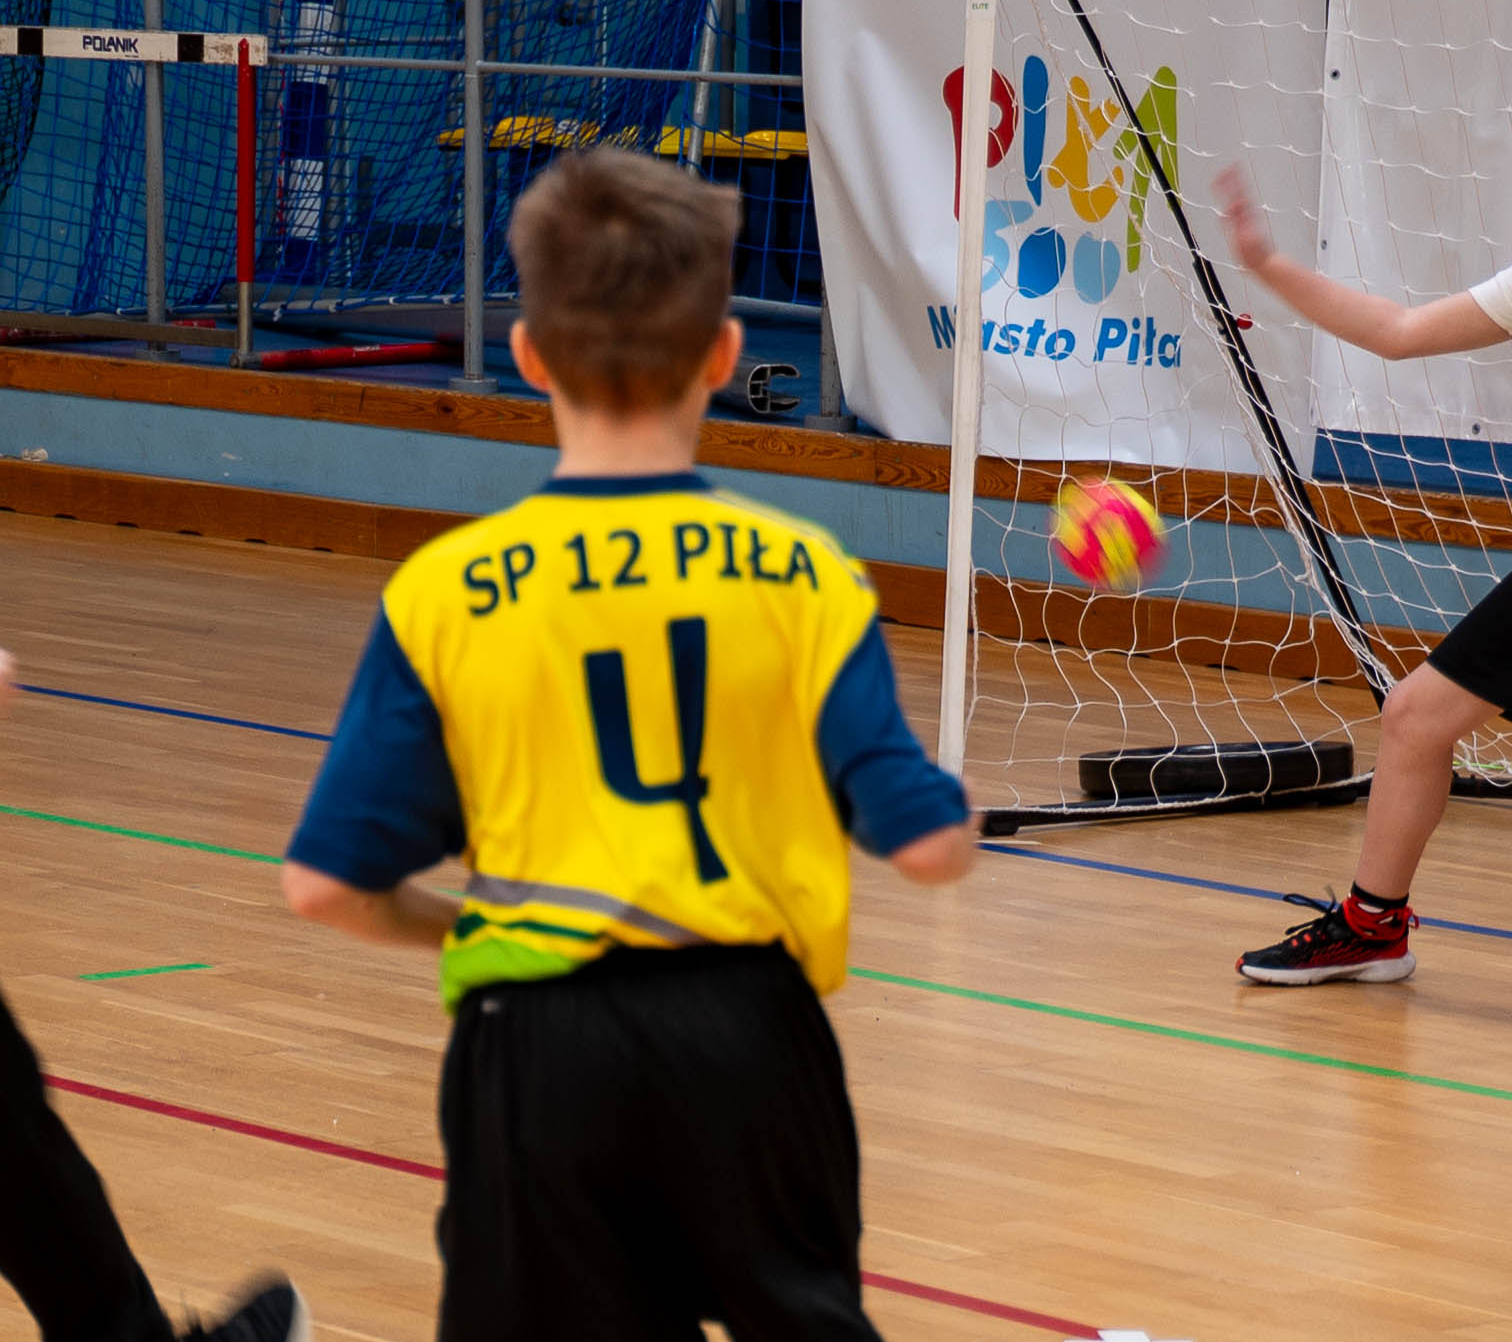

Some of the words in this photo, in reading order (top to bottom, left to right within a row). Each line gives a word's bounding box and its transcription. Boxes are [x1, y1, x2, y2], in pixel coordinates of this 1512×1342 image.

[82, 34, 139, 53] POLANIK
[927, 305, 1076, 361] Msto
[1092, 316, 1181, 368] Piła
[463, 542, 536, 617] SP
[565, 530, 647, 592] 12
[673, 523, 819, 591] PIŁA
[583, 616, 729, 885] 4
